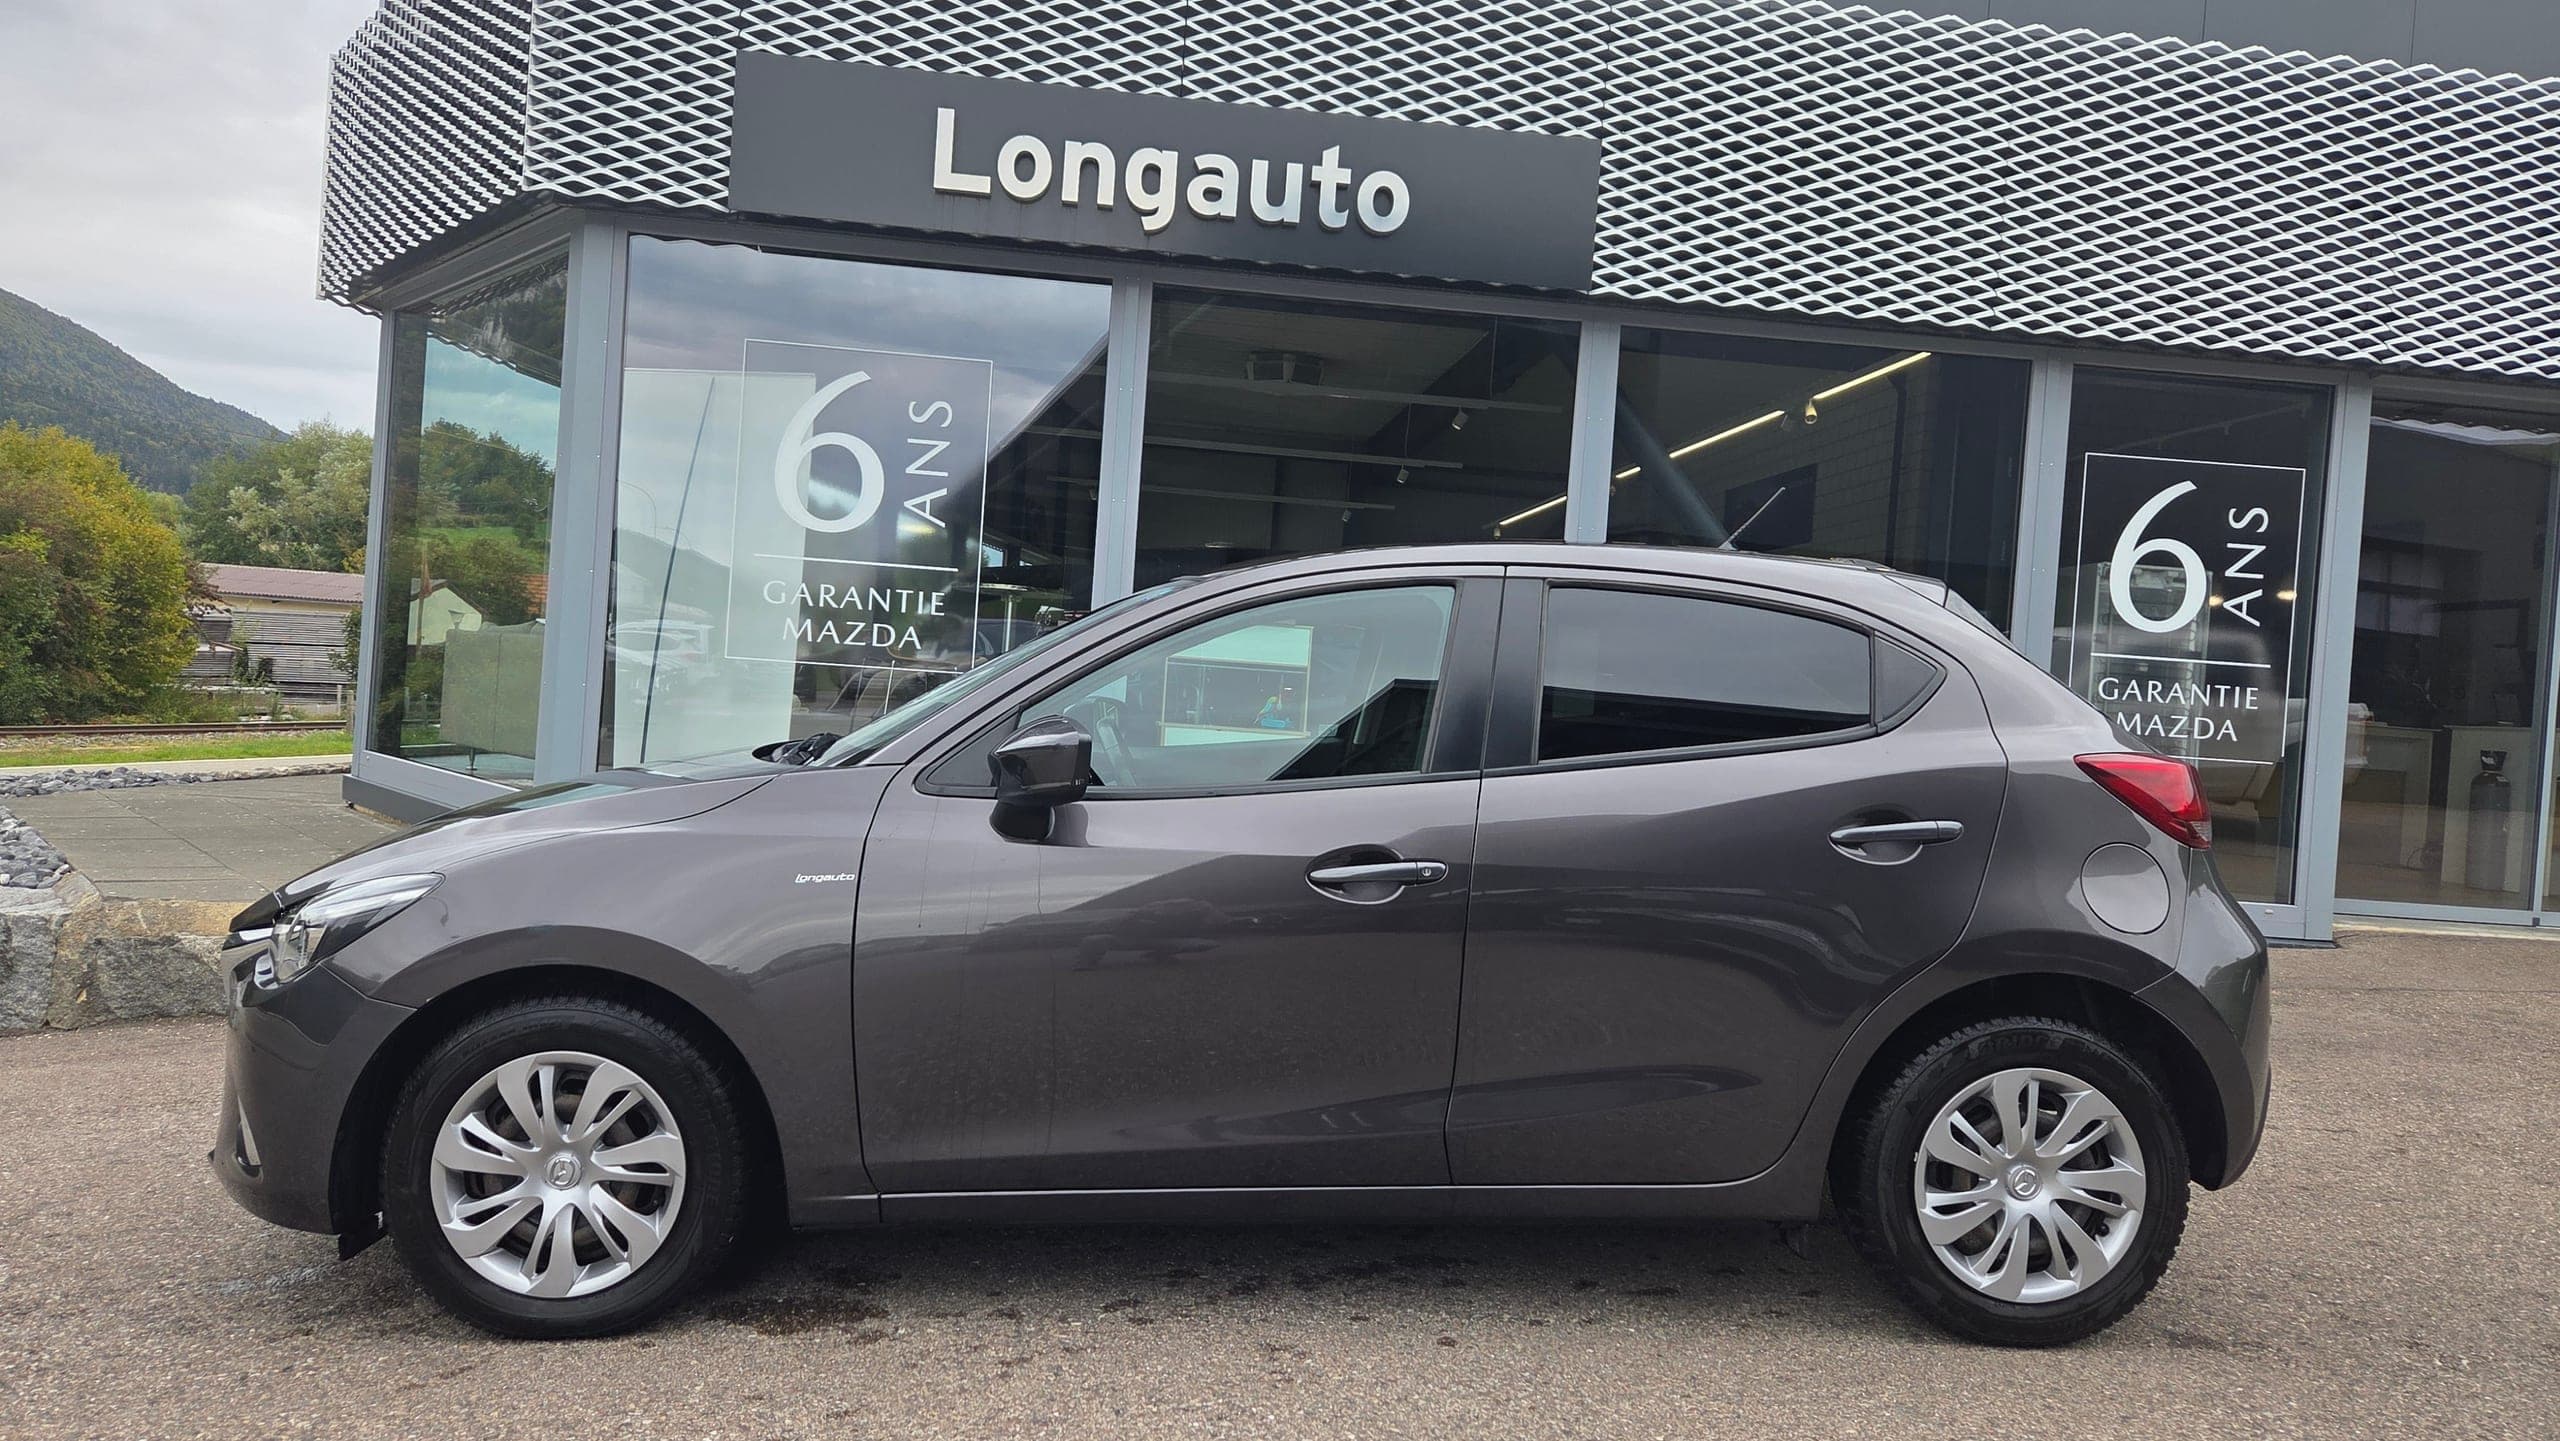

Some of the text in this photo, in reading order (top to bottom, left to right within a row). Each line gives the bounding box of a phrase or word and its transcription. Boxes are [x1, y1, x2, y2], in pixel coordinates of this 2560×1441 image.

[933, 106, 1411, 236] Longauto
[774, 370, 885, 533] 6
[903, 400, 953, 529] ANS
[763, 580, 946, 617] GARANTIE
[2109, 480, 2207, 633] 6
[2222, 507, 2269, 627] ANS
[782, 617, 922, 651] MAZDA
[2098, 677, 2259, 710] GARANTIE
[2116, 711, 2238, 742] MAZDA
